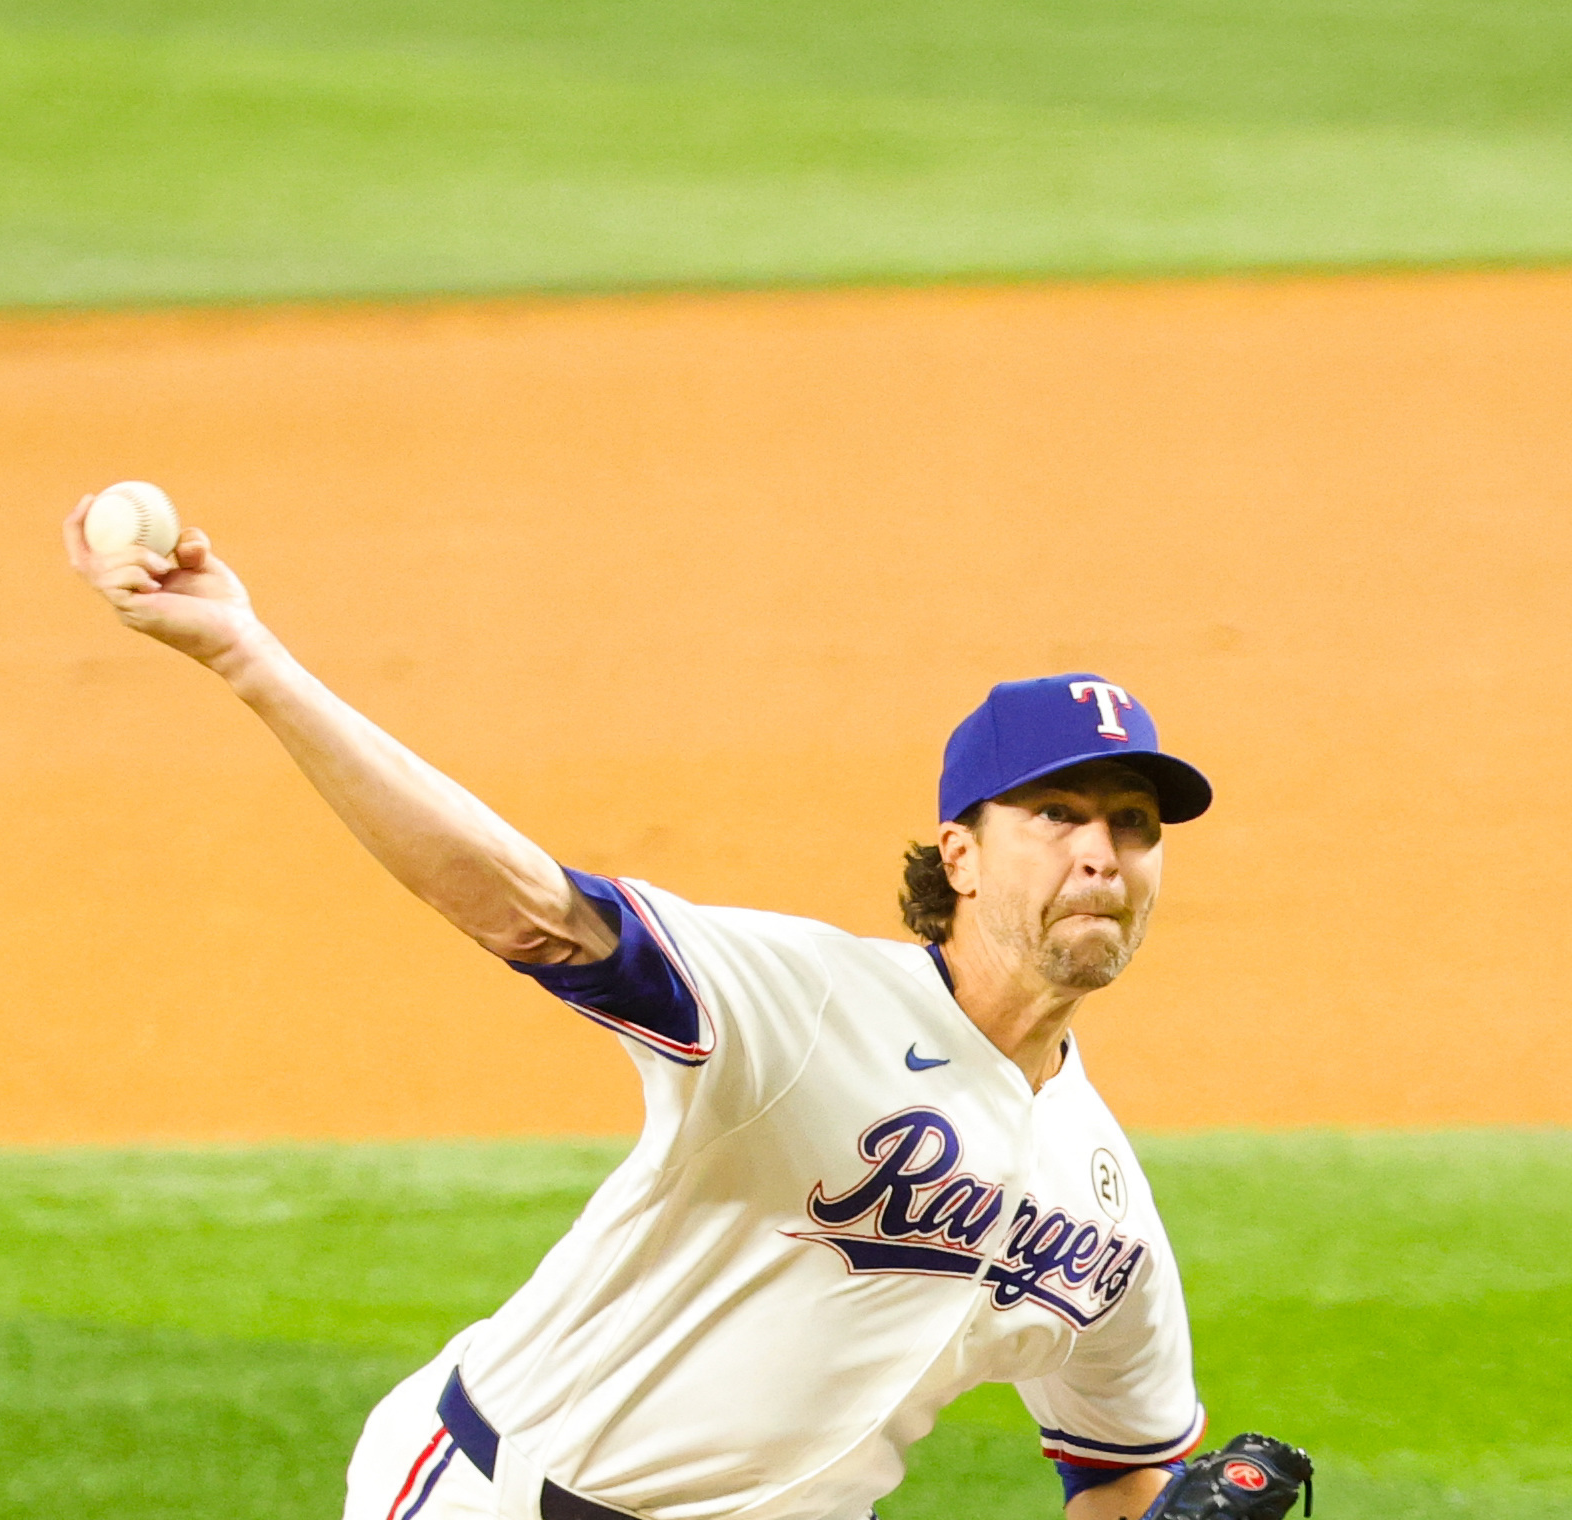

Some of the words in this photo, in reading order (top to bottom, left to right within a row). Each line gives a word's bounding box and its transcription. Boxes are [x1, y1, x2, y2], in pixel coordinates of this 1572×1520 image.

[1069, 681, 1133, 742] T
[806, 1105, 1149, 1311] Rangers
[1100, 1163, 1121, 1207] 21
